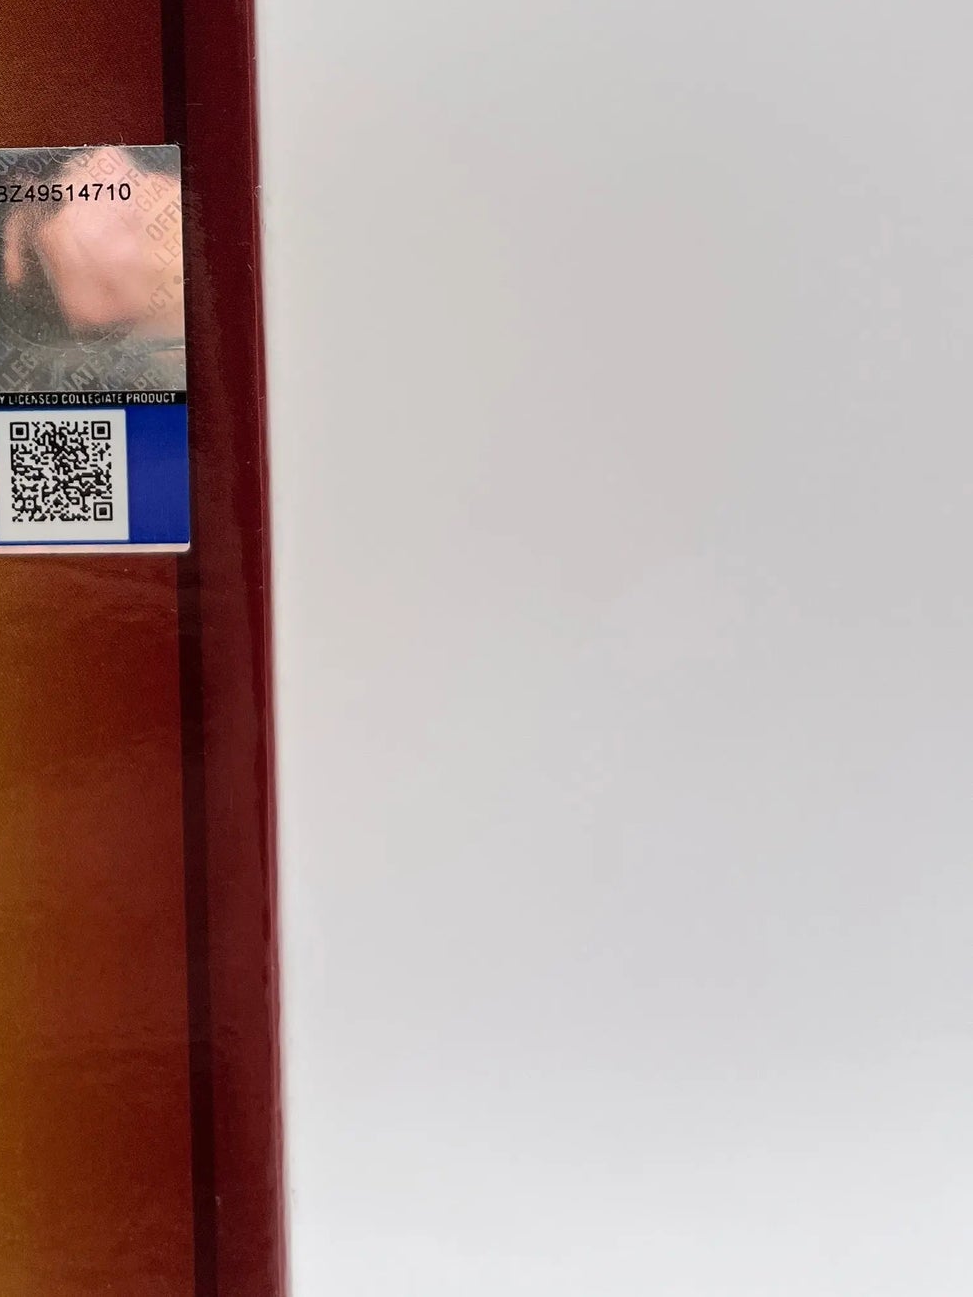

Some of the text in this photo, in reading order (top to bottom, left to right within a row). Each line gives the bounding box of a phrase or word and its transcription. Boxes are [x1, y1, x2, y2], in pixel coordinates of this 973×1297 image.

[8, 393, 59, 405] LICENSED
[61, 393, 123, 405] COLLEGIATE
[126, 392, 176, 404] PRODUCT
